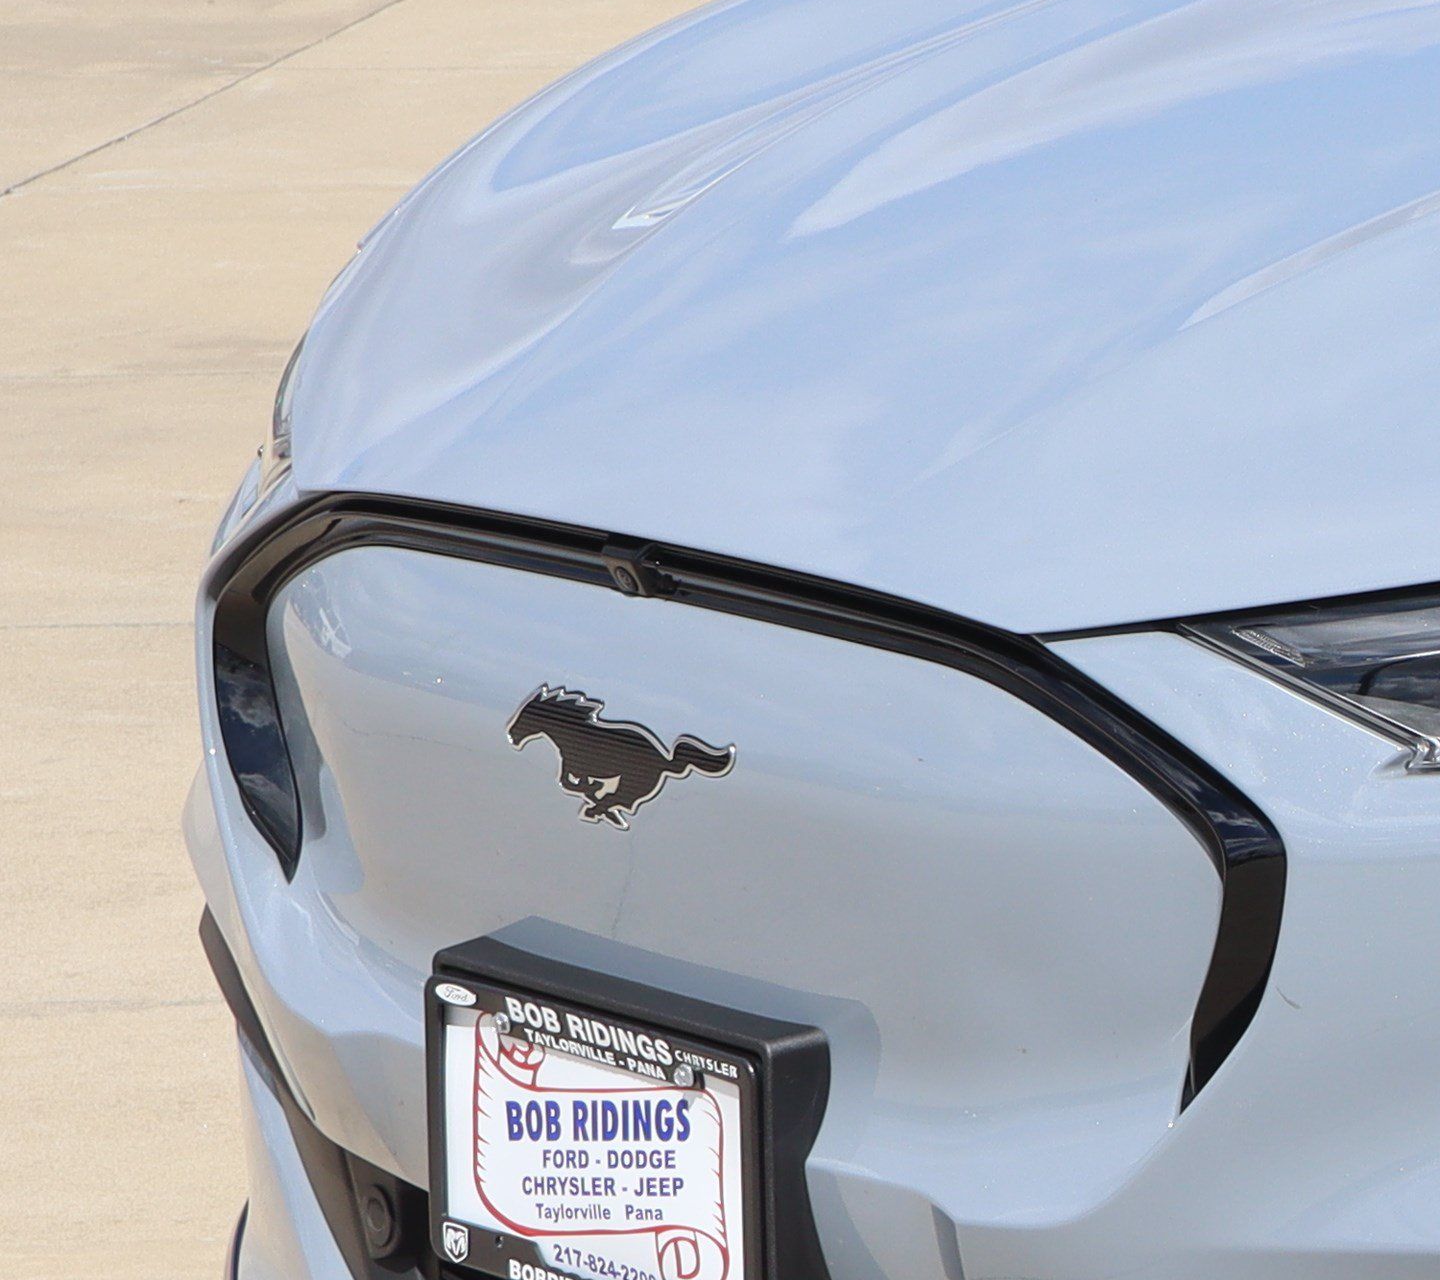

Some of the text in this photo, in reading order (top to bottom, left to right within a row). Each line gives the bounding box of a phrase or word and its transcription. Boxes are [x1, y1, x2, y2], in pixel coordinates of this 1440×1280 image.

[505, 996, 561, 1033] BOB
[565, 1013, 673, 1066] RIDINGS
[524, 1028, 616, 1066] TAYLORVILLE
[627, 1057, 667, 1080] PANA
[674, 1050, 738, 1079] CHRYSLER
[505, 1099, 691, 1142] BOB RIDINGS
[542, 1149, 590, 1169] FORD
[607, 1149, 676, 1169] DODGE
[522, 1176, 616, 1196] CHRYSLER
[634, 1177, 684, 1197] JEEP
[535, 1203, 663, 1224] Taylorville Pana
